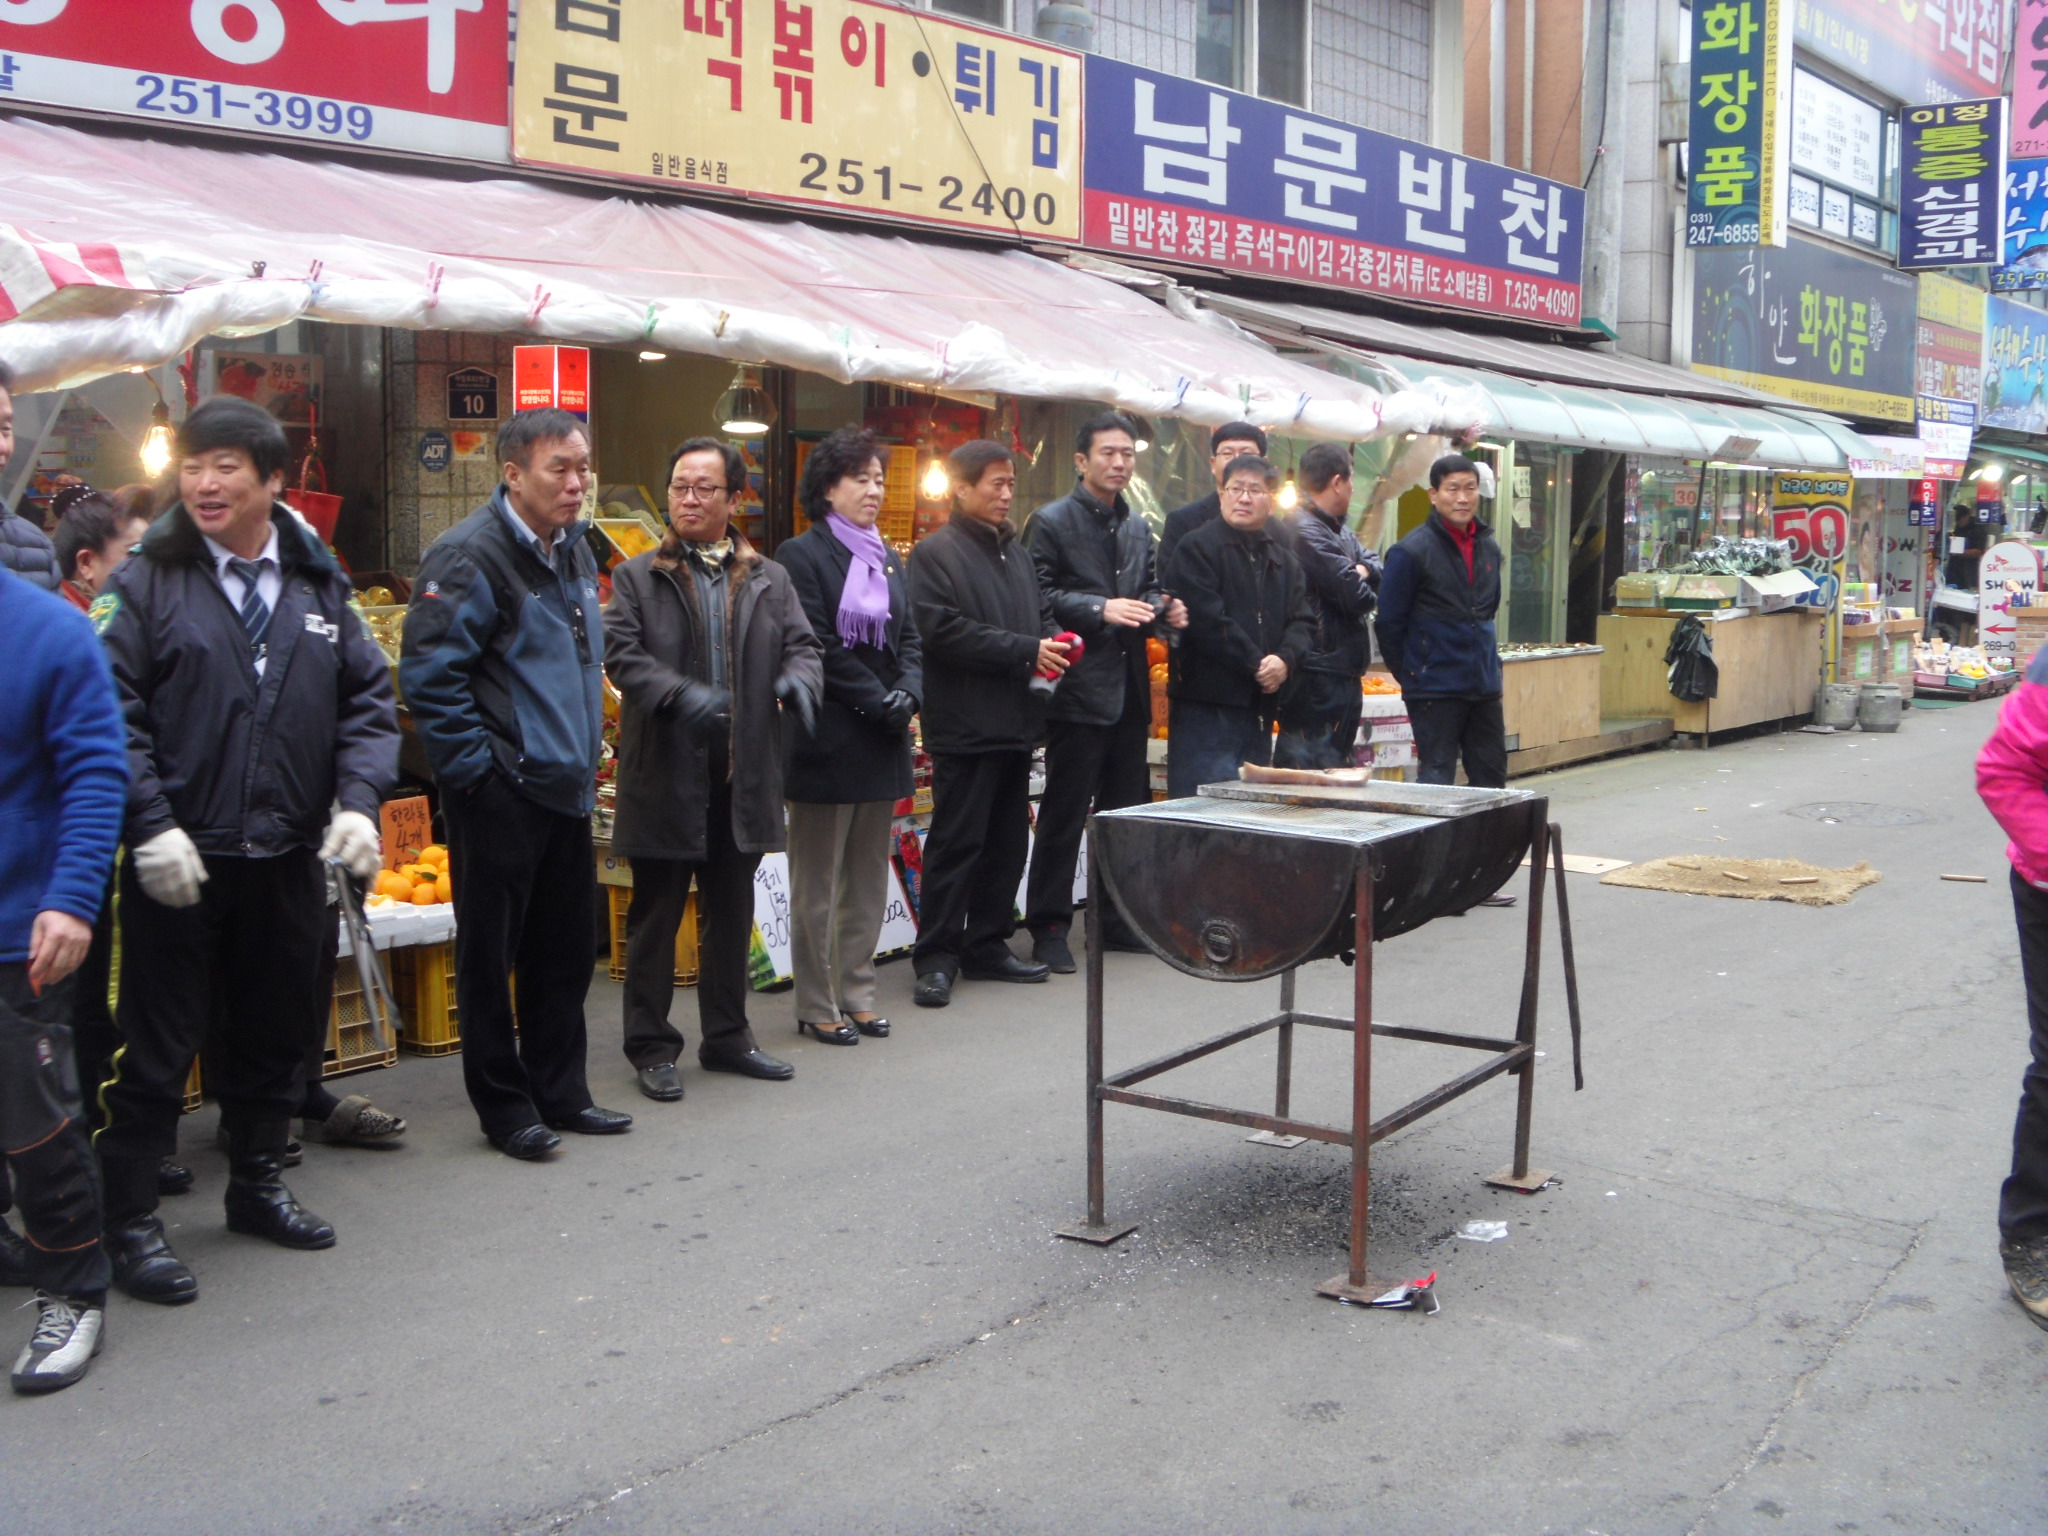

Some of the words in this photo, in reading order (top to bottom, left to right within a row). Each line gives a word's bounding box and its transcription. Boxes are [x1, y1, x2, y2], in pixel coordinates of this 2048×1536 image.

[135, 75, 373, 140] 251-3999
[955, 42, 1059, 169] 튀김
[1696, 2, 1759, 207] 화장품
[1910, 103, 1988, 124] 이정
[652, 152, 727, 185] 일반음식점
[1134, 78, 1568, 274] 남문반찬
[2006, 166, 2048, 201] 서
[800, 152, 1056, 226] 251-2400
[1689, 224, 1759, 244] 247-6855
[1690, 213, 1713, 225] 031)
[1912, 183, 1987, 259] 신경과
[1504, 279, 1575, 318] T.258-4090
[1798, 284, 1869, 376] 화장품
[463, 395, 485, 414] 10
[423, 445, 446, 459] ADT
[1675, 490, 1697, 505] 30
[1986, 564, 1999, 572] SK
[2003, 565, 2033, 573] telecom
[396, 826, 423, 853] 4개
